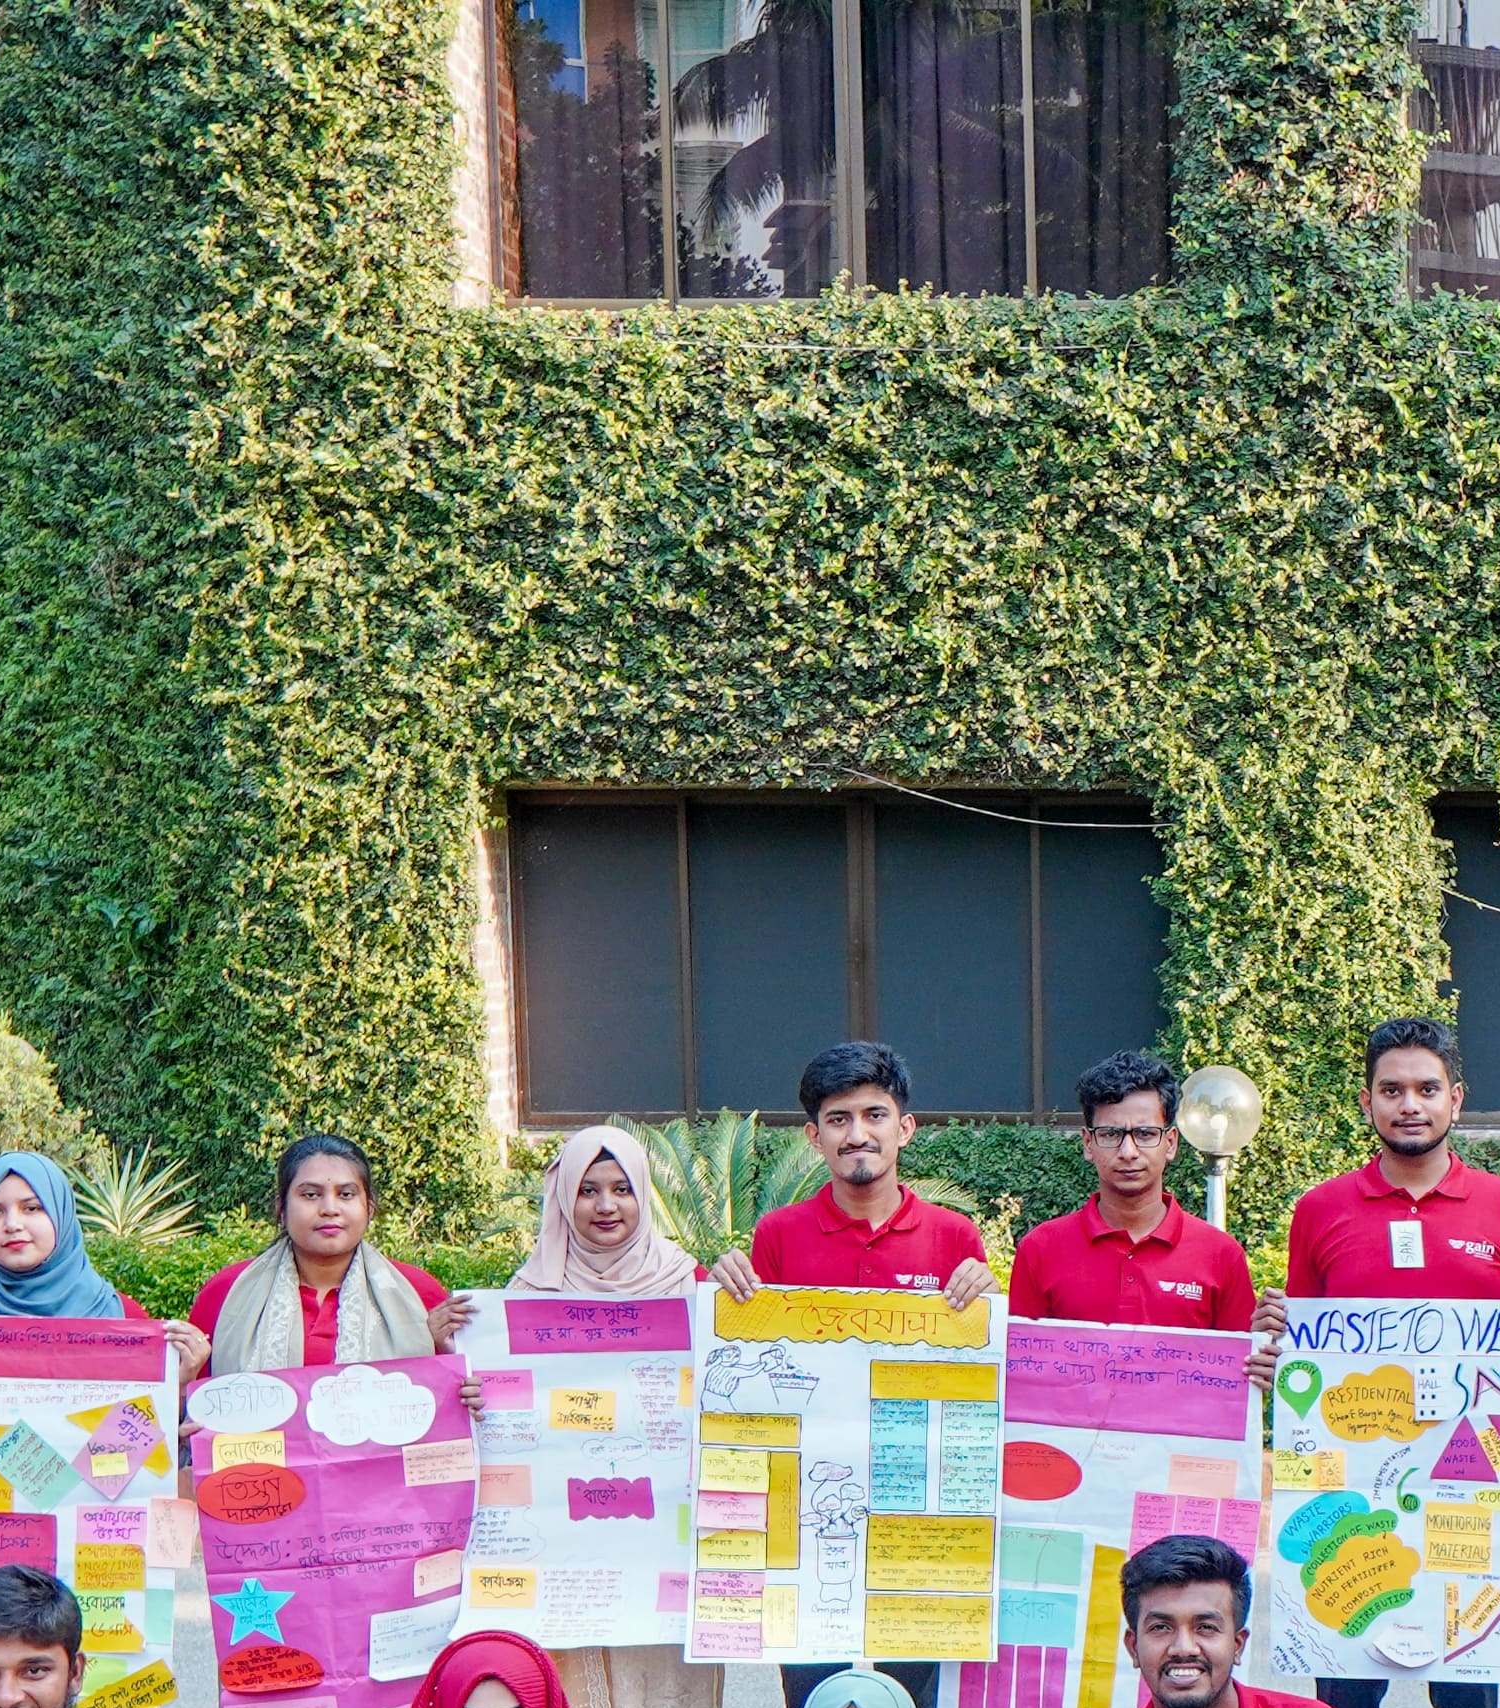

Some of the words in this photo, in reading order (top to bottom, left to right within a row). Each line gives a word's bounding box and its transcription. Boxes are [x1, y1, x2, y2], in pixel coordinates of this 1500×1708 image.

[1465, 1240, 1496, 1257] gain
[913, 1273, 940, 1289] gain
[1176, 1281, 1202, 1297] gain
[1286, 1304, 1401, 1354] WASTE
[1399, 1300, 1446, 1354] TO
[1416, 1379, 1440, 1390] HALL
[1449, 1437, 1478, 1450] FOOD
[1284, 1500, 1328, 1540] WASTE
[1426, 1512, 1493, 1533] MONITORING
[1343, 1523, 1364, 1542] OF
[1365, 1517, 1398, 1531] WASTE
[1362, 1545, 1390, 1563] RICH
[1427, 1540, 1493, 1563] MATERIALS
